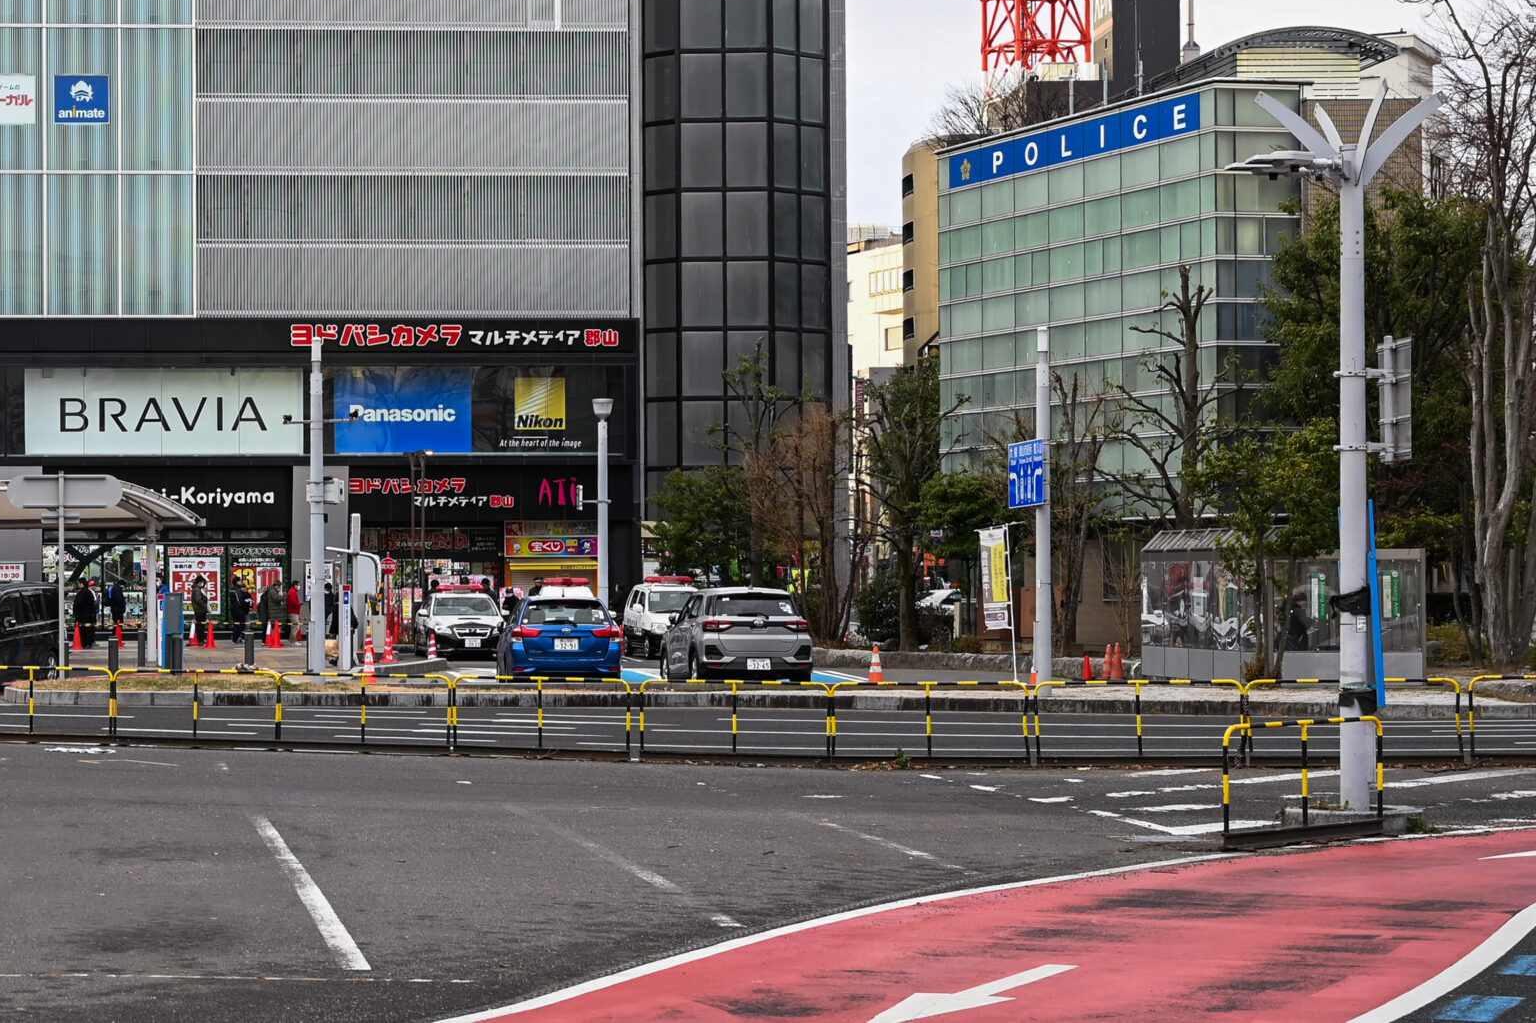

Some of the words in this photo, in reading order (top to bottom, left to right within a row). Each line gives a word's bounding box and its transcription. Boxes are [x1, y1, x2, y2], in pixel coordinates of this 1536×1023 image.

[58, 104, 106, 118] animate
[992, 103, 1187, 174] POLICE
[290, 324, 463, 347] ヨドバシカメラ
[59, 396, 268, 433] BRAVIA
[349, 404, 456, 423] Panasonic
[516, 414, 564, 429] Nikon
[499, 438, 508, 447] At
[509, 438, 520, 447] the
[521, 438, 540, 448] heart
[540, 438, 549, 448] of
[549, 438, 560, 448] the
[561, 438, 582, 448] image
[349, 478, 466, 494] ヨドバシカメラ
[168, 546, 224, 556] ヨドバシカメラ
[531, 541, 561, 552] 宝くじ
[179, 572, 210, 582] TAX
[174, 581, 216, 591] FRE
